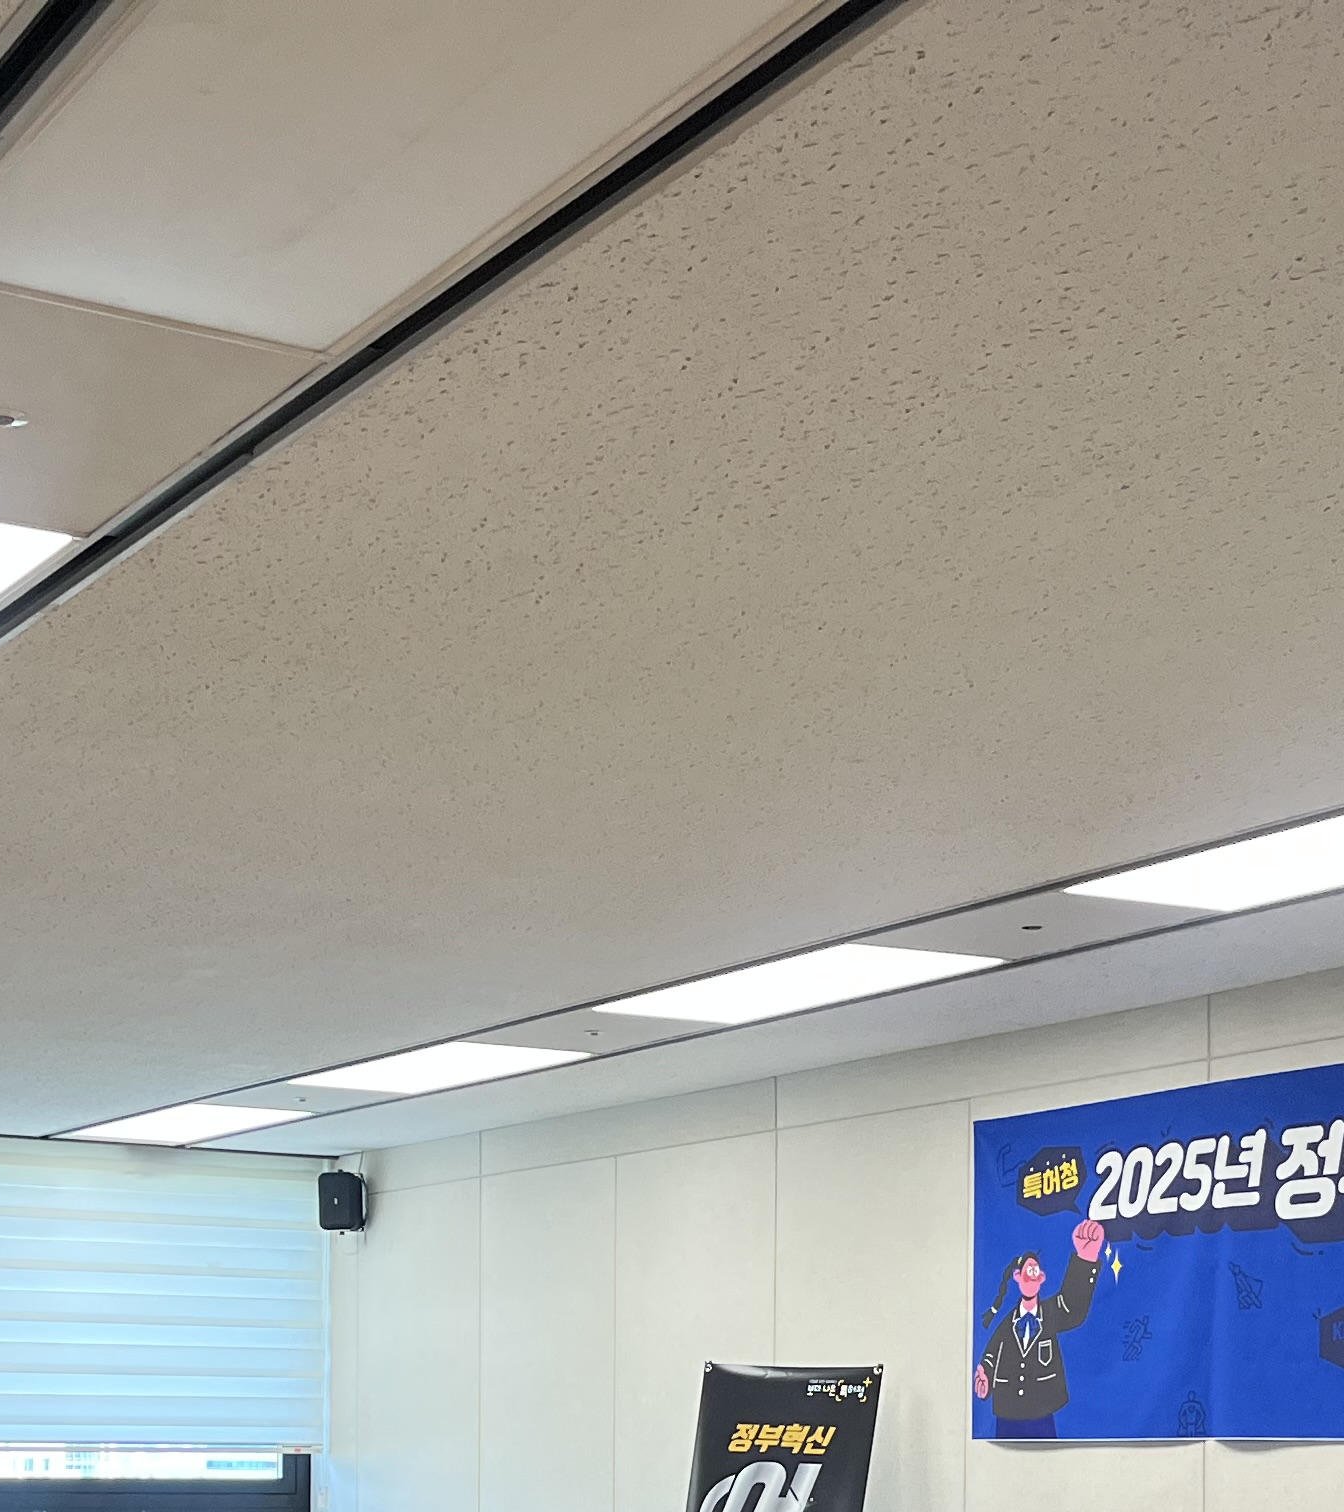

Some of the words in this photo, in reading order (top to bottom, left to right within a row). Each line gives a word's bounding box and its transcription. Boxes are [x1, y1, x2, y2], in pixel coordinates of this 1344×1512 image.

[1022, 1158, 1079, 1199] 특허청
[1088, 1129, 1267, 1221] 2025년
[727, 1423, 836, 1456] 정부혁신
